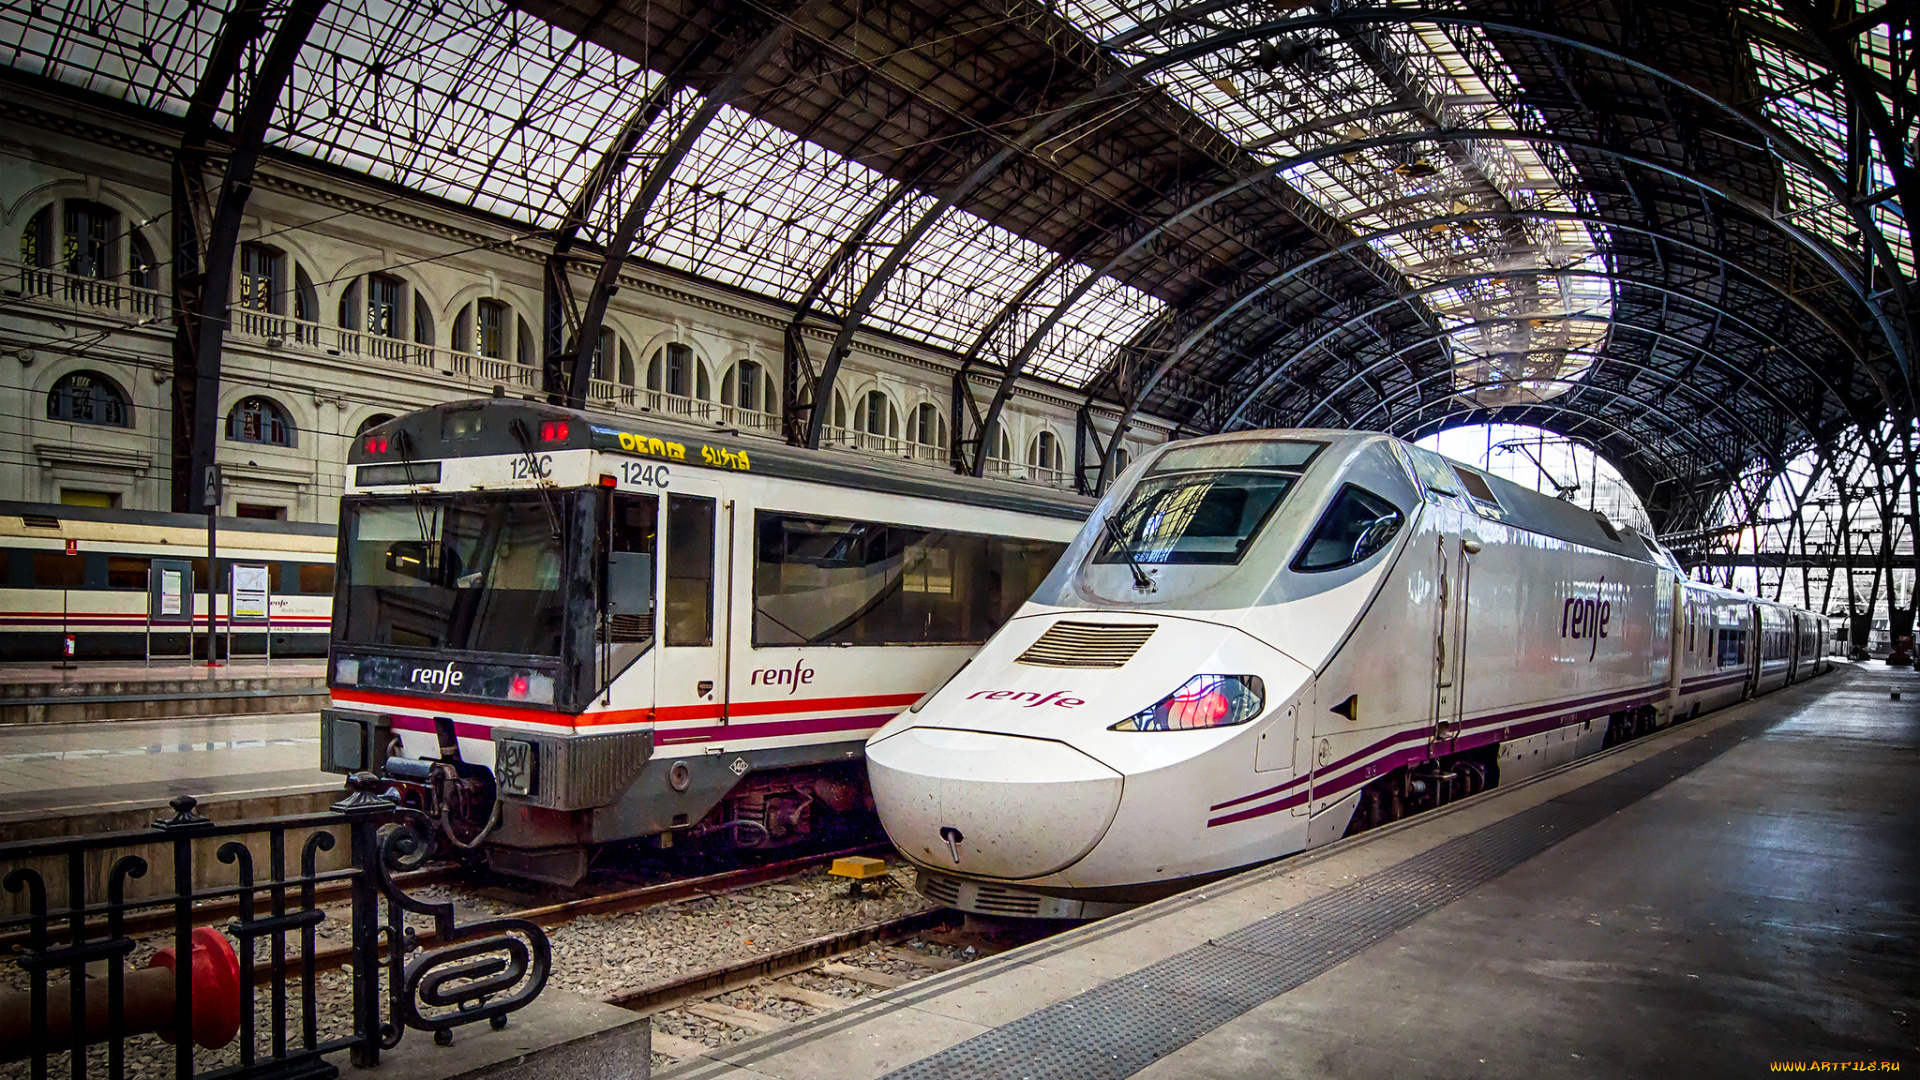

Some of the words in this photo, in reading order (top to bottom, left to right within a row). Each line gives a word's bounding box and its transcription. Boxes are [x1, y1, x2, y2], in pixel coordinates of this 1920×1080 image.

[206, 471, 216, 490] A
[510, 455, 552, 480] 124C
[621, 461, 670, 488] 124C
[1562, 575, 1611, 662] renfe
[410, 661, 463, 694] renfe
[751, 658, 815, 695] renfe
[966, 690, 1085, 709] renfe
